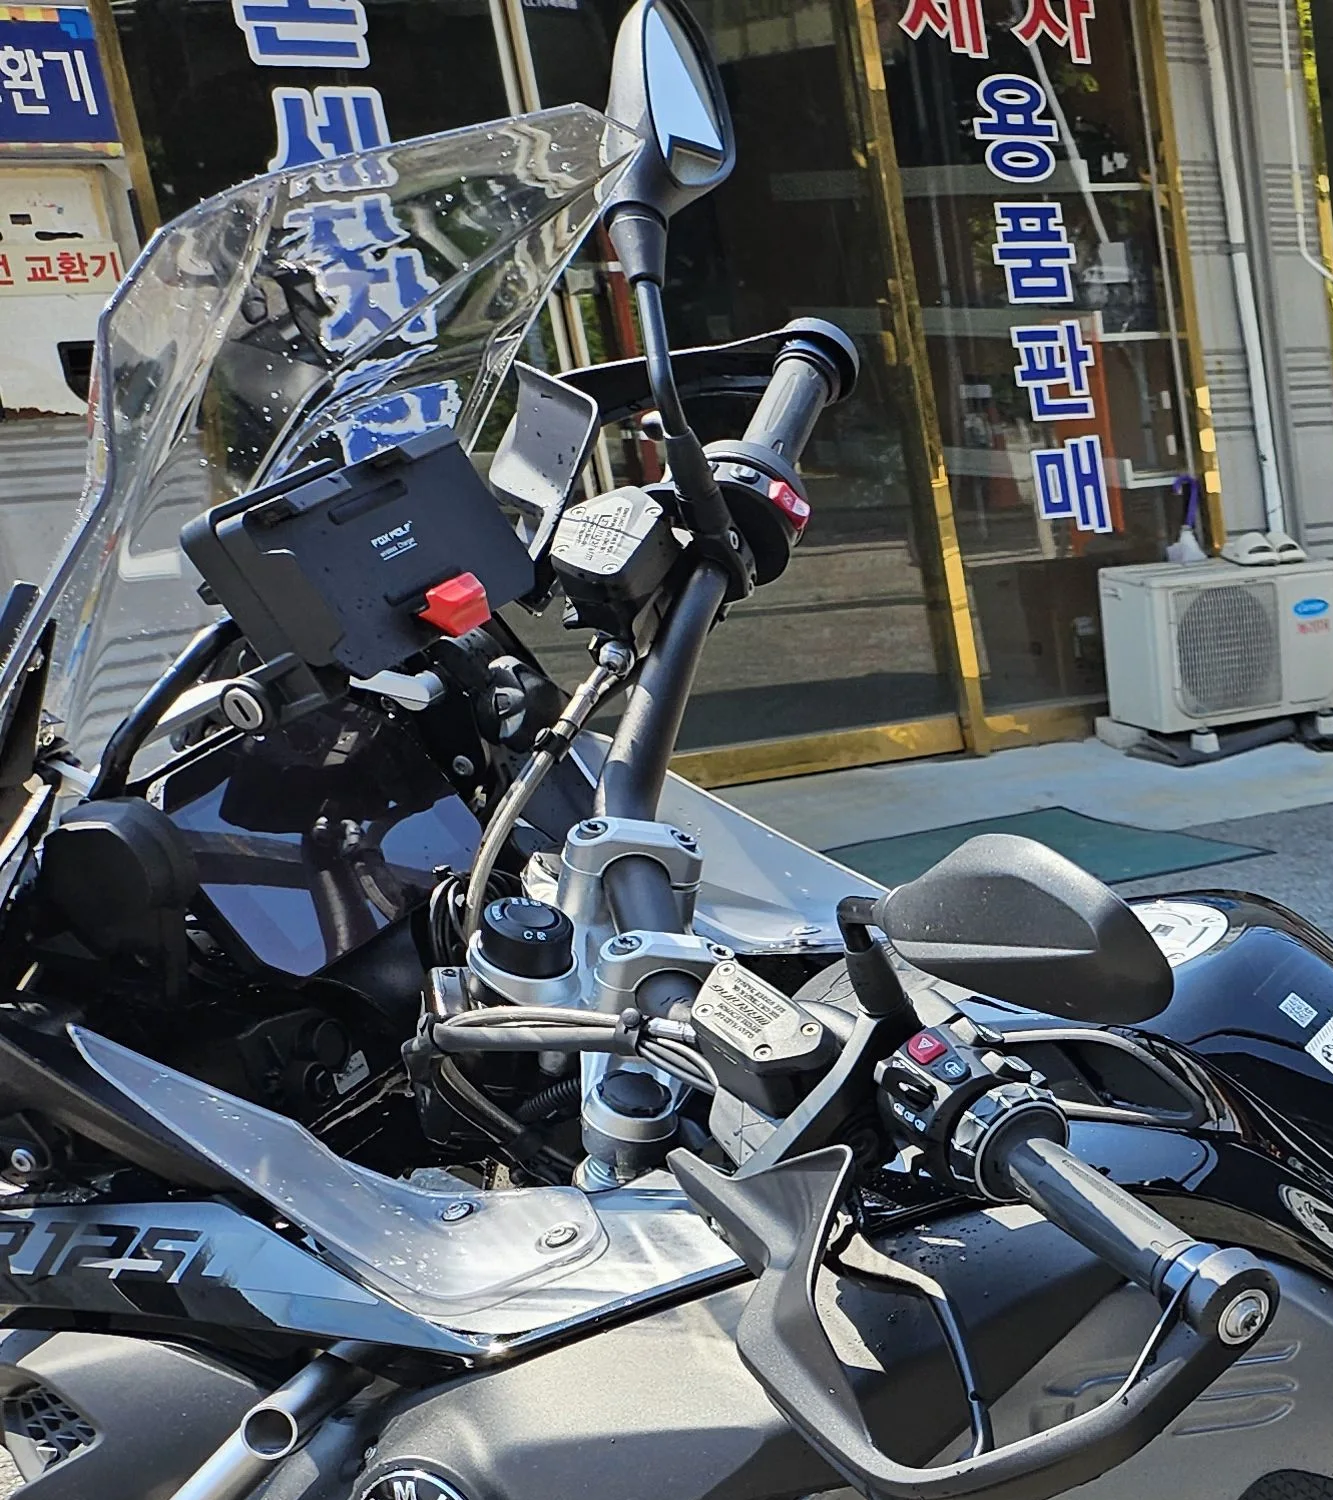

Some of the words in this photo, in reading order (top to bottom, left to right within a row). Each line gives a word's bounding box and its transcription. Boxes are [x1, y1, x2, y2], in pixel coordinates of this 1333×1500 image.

[0, 45, 99, 116] 환기
[25, 251, 122, 284] 교환기
[973, 74, 1113, 534] 용품판매
